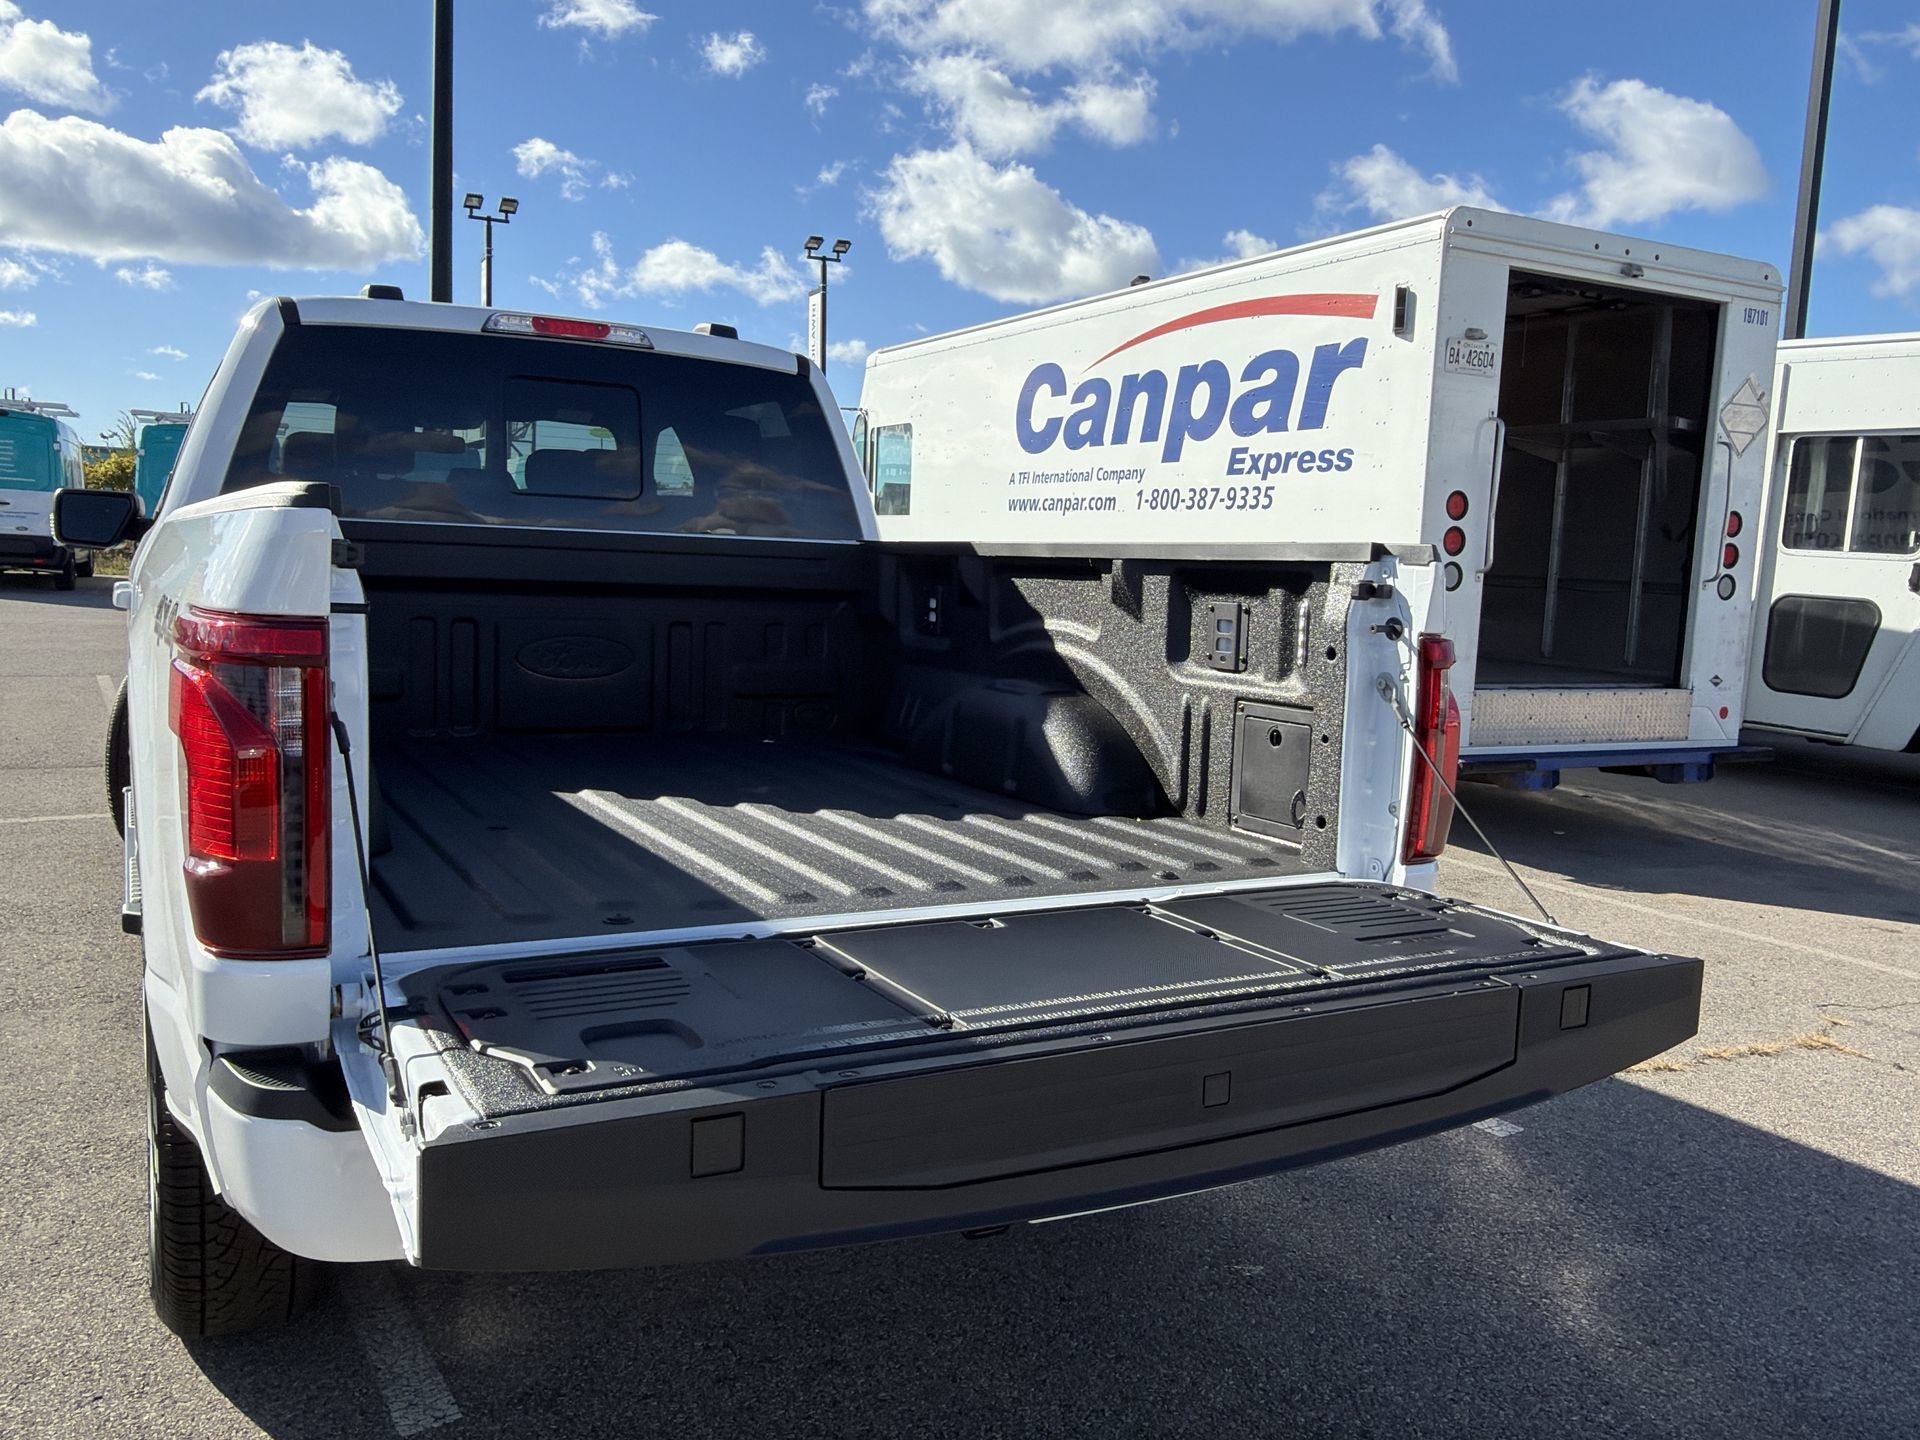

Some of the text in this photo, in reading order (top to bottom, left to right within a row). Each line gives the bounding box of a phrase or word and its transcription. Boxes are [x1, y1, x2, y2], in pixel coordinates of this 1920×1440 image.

[1448, 346, 1495, 369] BA 42604
[1015, 336, 1369, 464] Canpar
[1008, 467, 1146, 486] A TFI International Company
[1226, 446, 1355, 481] Express
[1008, 486, 1275, 516] www.canpar.com 1-800-387-9335
